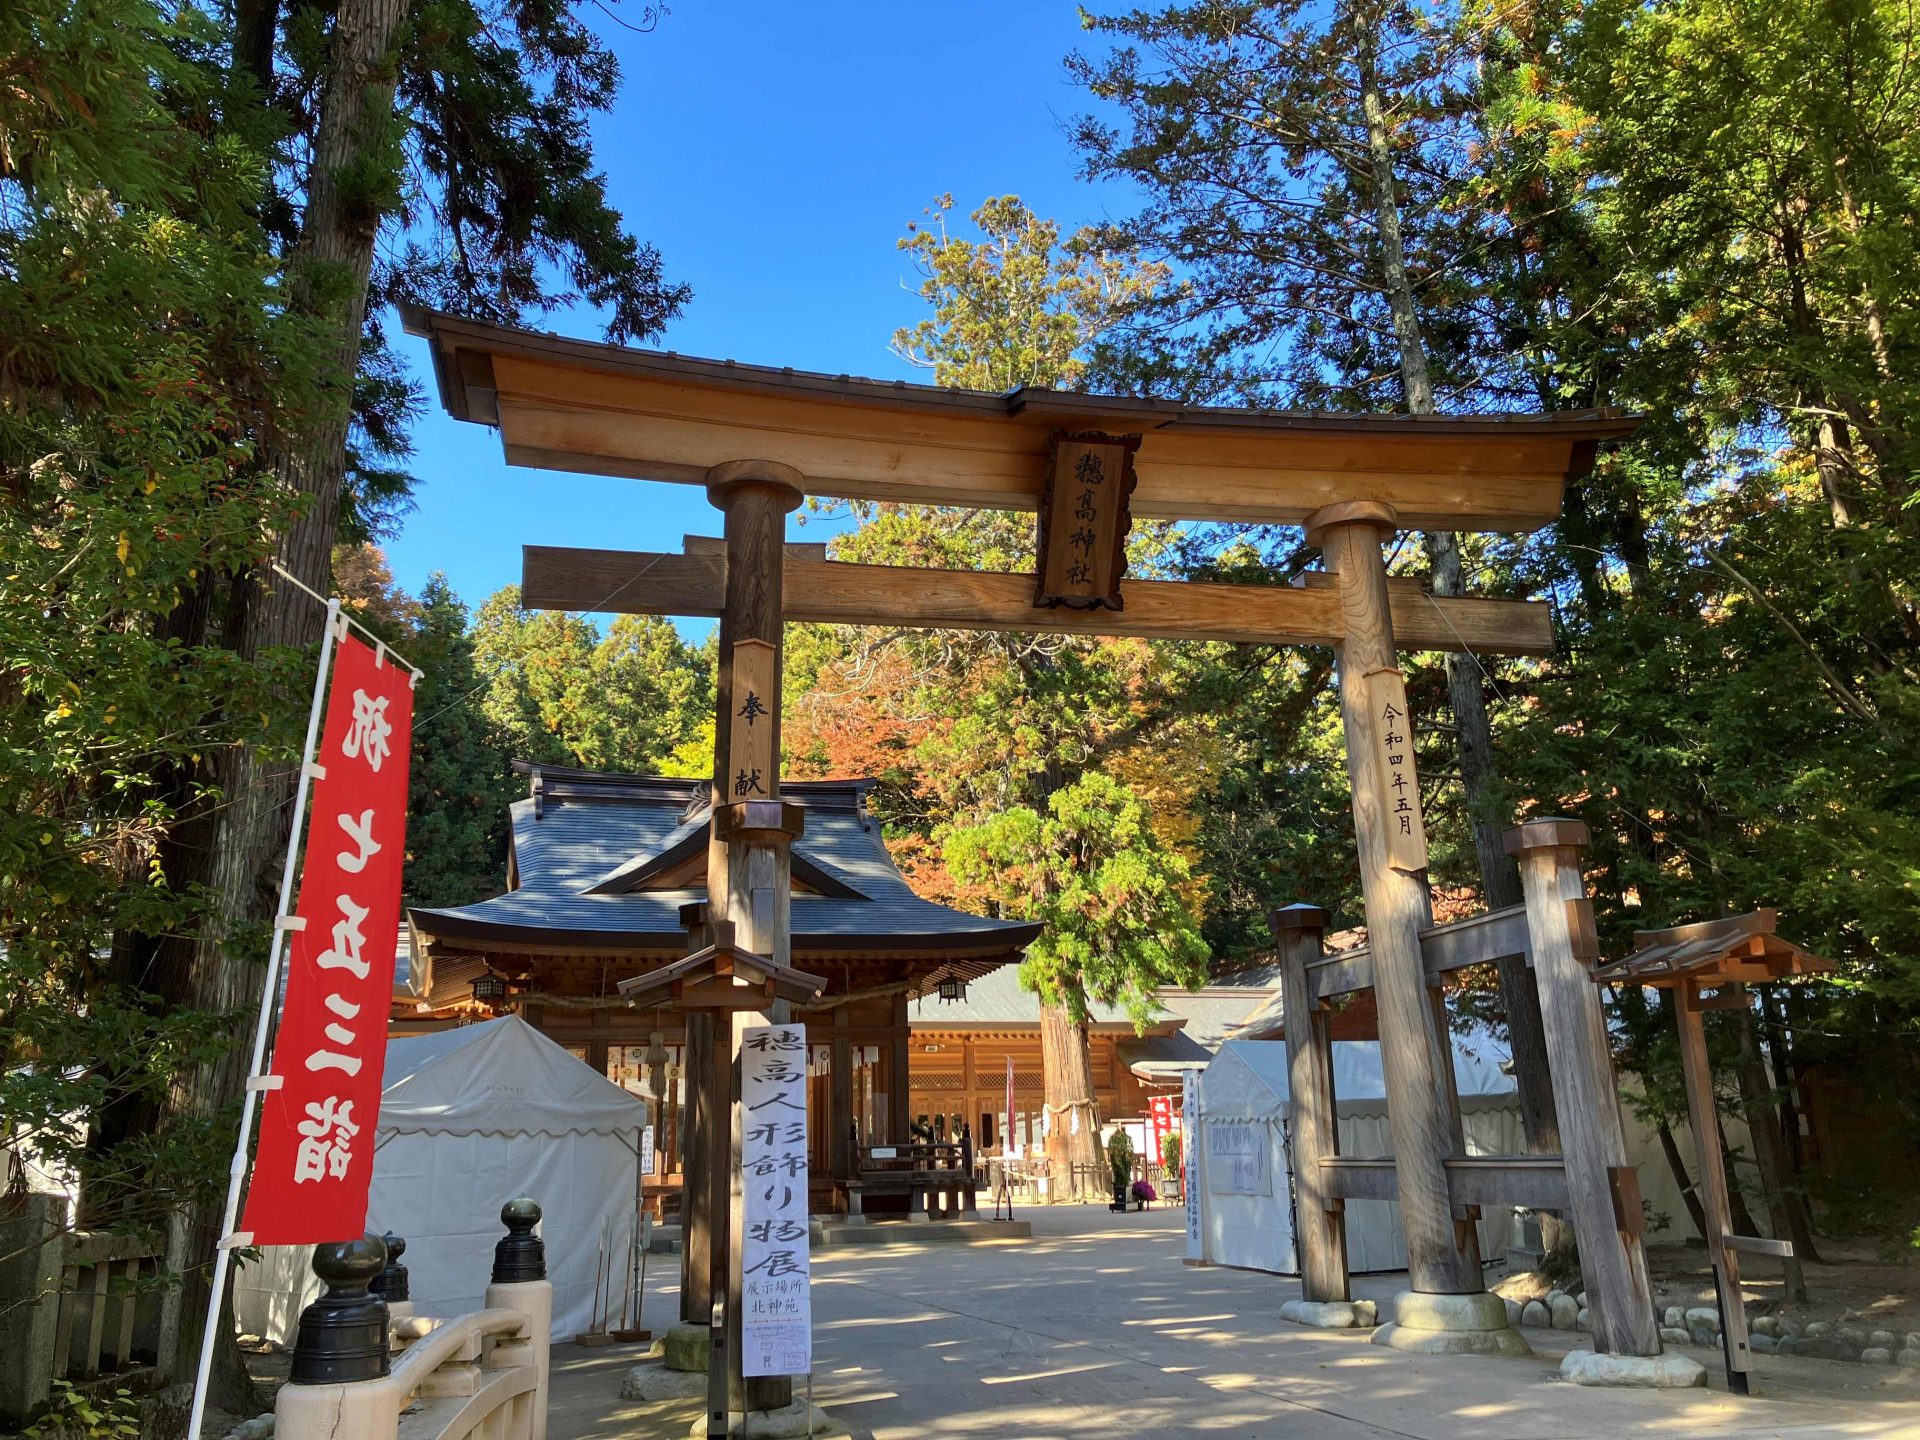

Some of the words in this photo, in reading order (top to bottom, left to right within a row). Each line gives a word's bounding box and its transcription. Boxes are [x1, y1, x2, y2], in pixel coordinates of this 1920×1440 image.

[1066, 449, 1105, 586] 穂高神社
[735, 691, 768, 796] 奉献
[1382, 703, 1413, 835] 令和四年五月
[743, 1030, 807, 1278] 穂高人形飾り物展
[748, 1281, 802, 1296] 展示場所
[752, 1299, 798, 1315] 北神苑
